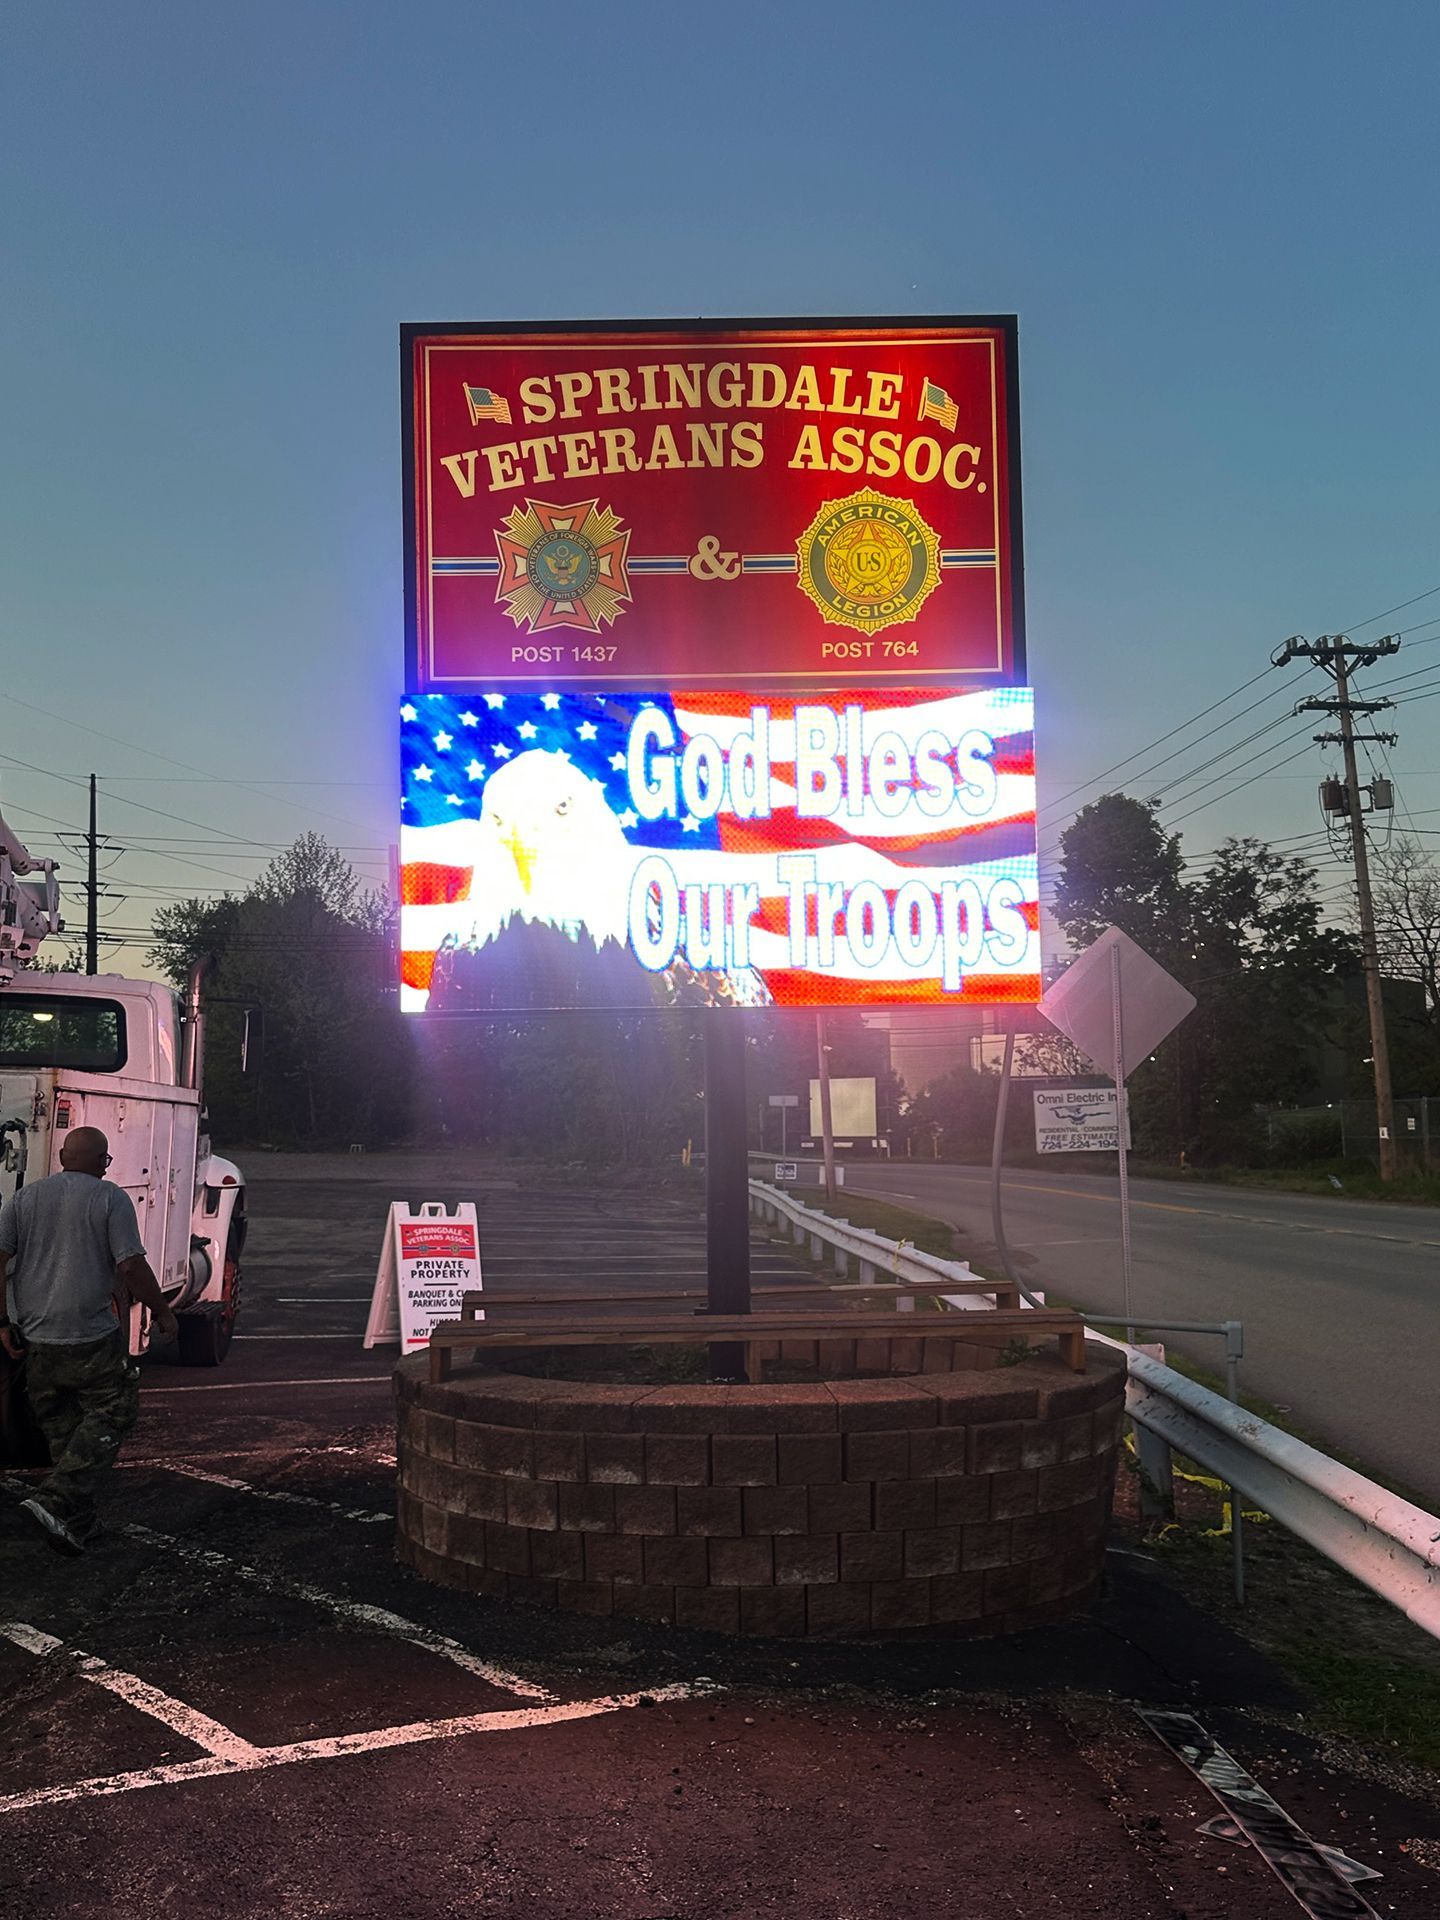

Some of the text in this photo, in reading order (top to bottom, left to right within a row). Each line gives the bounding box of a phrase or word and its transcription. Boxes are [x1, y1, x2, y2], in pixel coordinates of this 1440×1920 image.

[518, 361, 904, 425] SPRINGDALE
[441, 421, 988, 500] VETERANS ASSOC.
[818, 506, 921, 548] AMERICAN
[688, 535, 744, 581] &
[832, 593, 908, 617] LEGION
[511, 645, 618, 663] POST 1437
[821, 640, 919, 659] POST 764
[627, 704, 997, 820] God Bless
[628, 853, 1030, 992] Our Troops
[1037, 1091, 1118, 1104] Omni Electric In
[1040, 1140, 1119, 1150] 724-224-194
[413, 1226, 463, 1237] SPRINGDALE
[407, 1235, 443, 1245] VETERANS
[416, 1260, 464, 1269] PRIVATE
[411, 1269, 470, 1279] PROPERTY
[408, 1290, 446, 1299] BANQUET
[412, 1299, 461, 1307] PARKING ON
[413, 1328, 429, 1337] NOT
